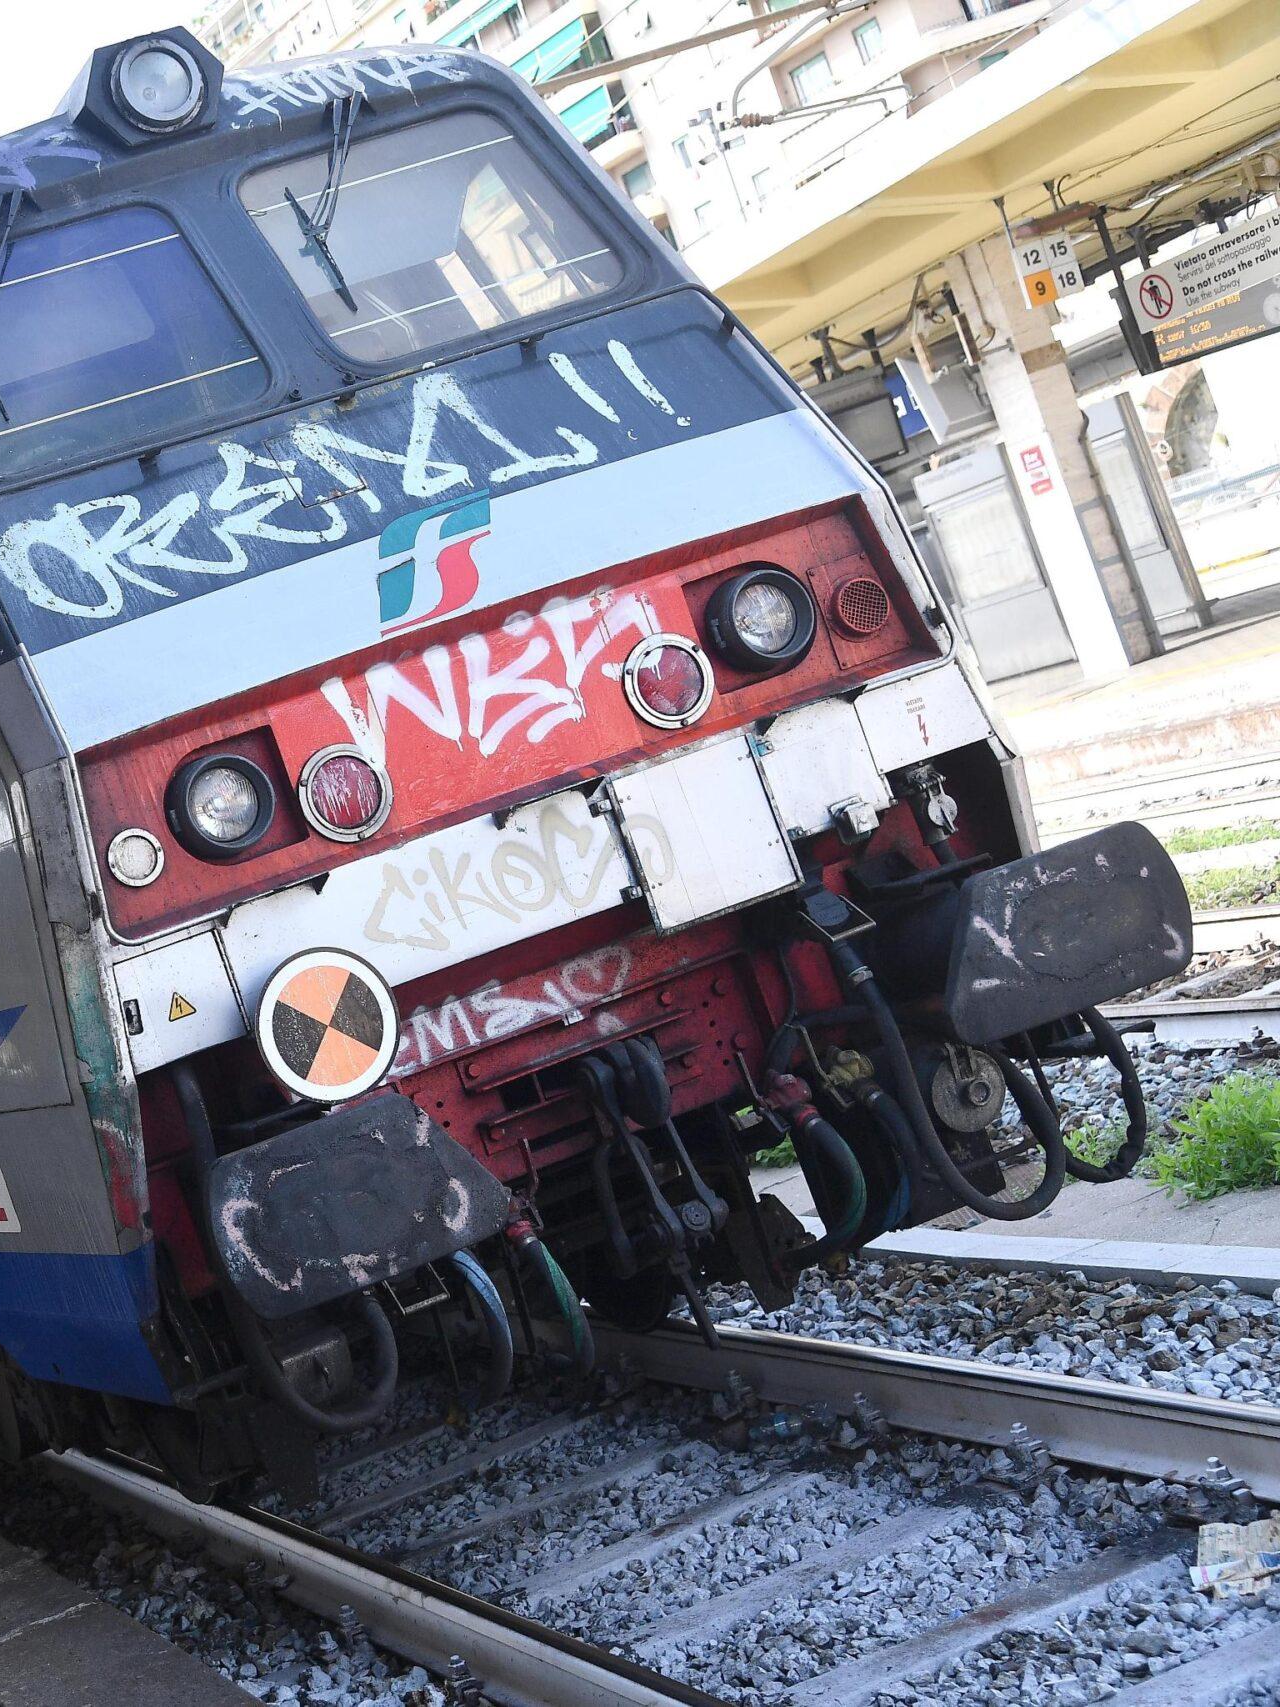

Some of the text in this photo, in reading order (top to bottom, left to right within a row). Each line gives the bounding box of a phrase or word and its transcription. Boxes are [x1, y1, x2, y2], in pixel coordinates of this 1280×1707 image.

[1023, 241, 1068, 266] 12 15
[1174, 252, 1206, 271] Vietato
[1208, 225, 1265, 256] attraversare
[1177, 235, 1271, 282] Servirsi del sottopassaggio
[1035, 271, 1077, 296] 9 18
[1182, 247, 1280, 296] Do not cross the railw
[1185, 295, 1200, 306] Use
[1201, 290, 1213, 300] the
[1214, 279, 1240, 296] subway
